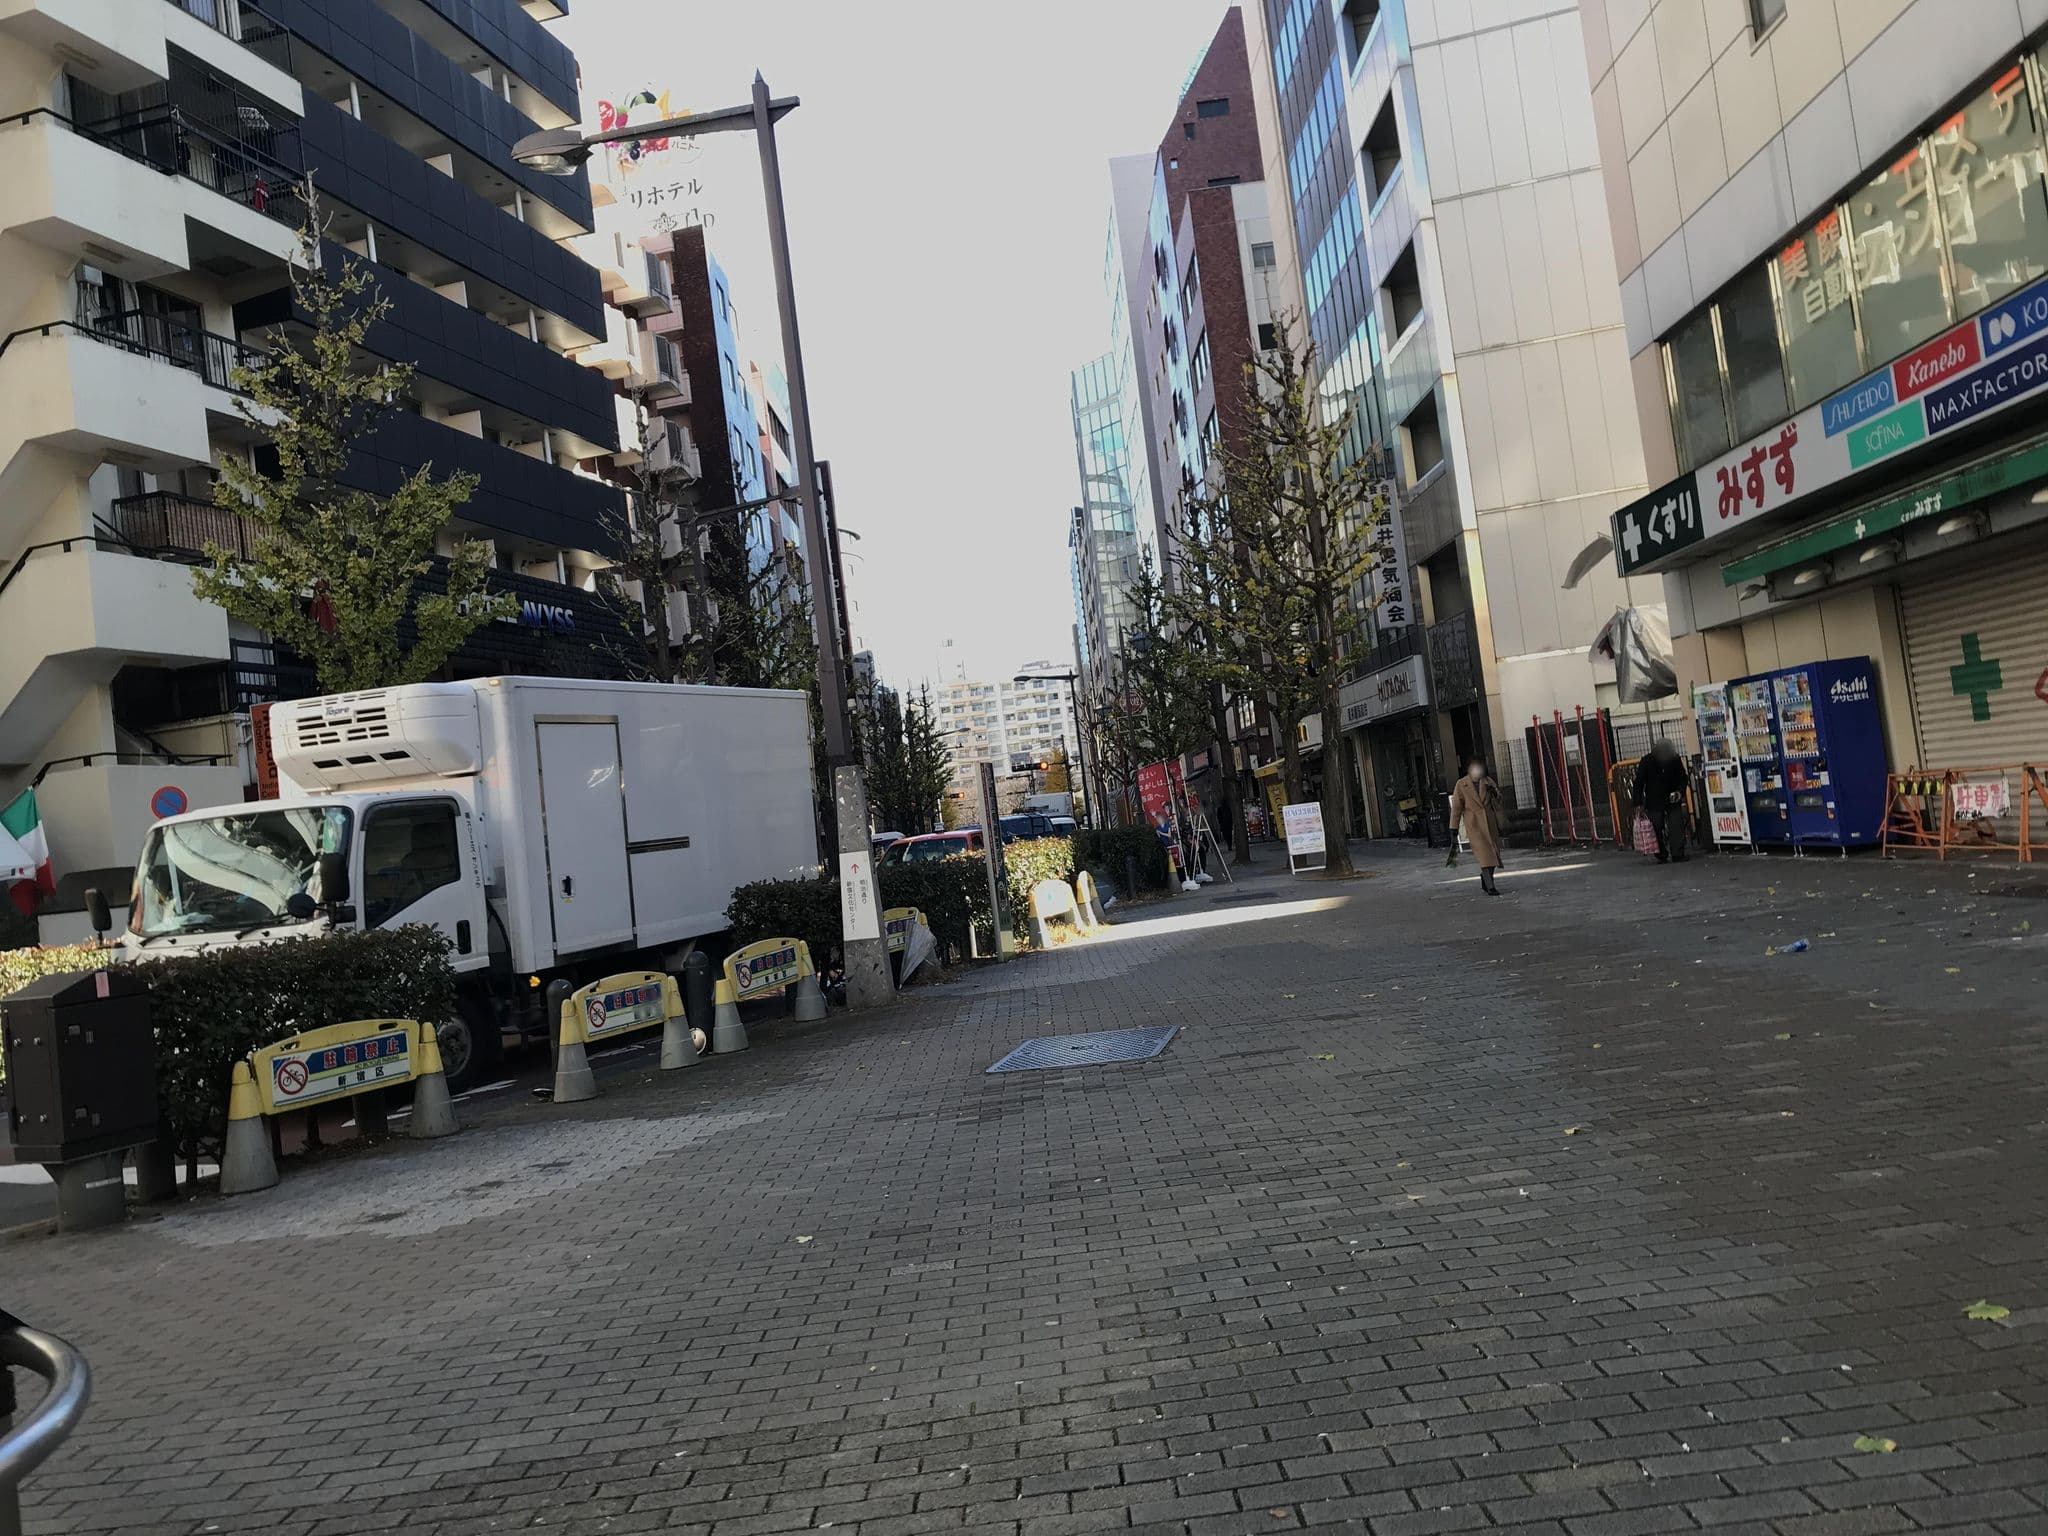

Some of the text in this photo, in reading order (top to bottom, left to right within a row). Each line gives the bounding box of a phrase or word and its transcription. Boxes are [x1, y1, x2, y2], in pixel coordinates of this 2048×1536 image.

[1907, 342, 1966, 389] Kanebo
[1827, 380, 1890, 430] SHISEIDO
[1865, 422, 1905, 453] SOFINA
[1716, 421, 1799, 519] みすず
[1647, 489, 1695, 545] くすり
[1377, 671, 1411, 703] HITACHI
[1830, 676, 1868, 695] Asahi
[1830, 692, 1870, 704] アサヒ飲料
[325, 706, 351, 716] Topre
[1717, 816, 1742, 833] KIRIN
[323, 1037, 400, 1069] 駐輪禁止
[338, 1066, 385, 1087] 新宿区
